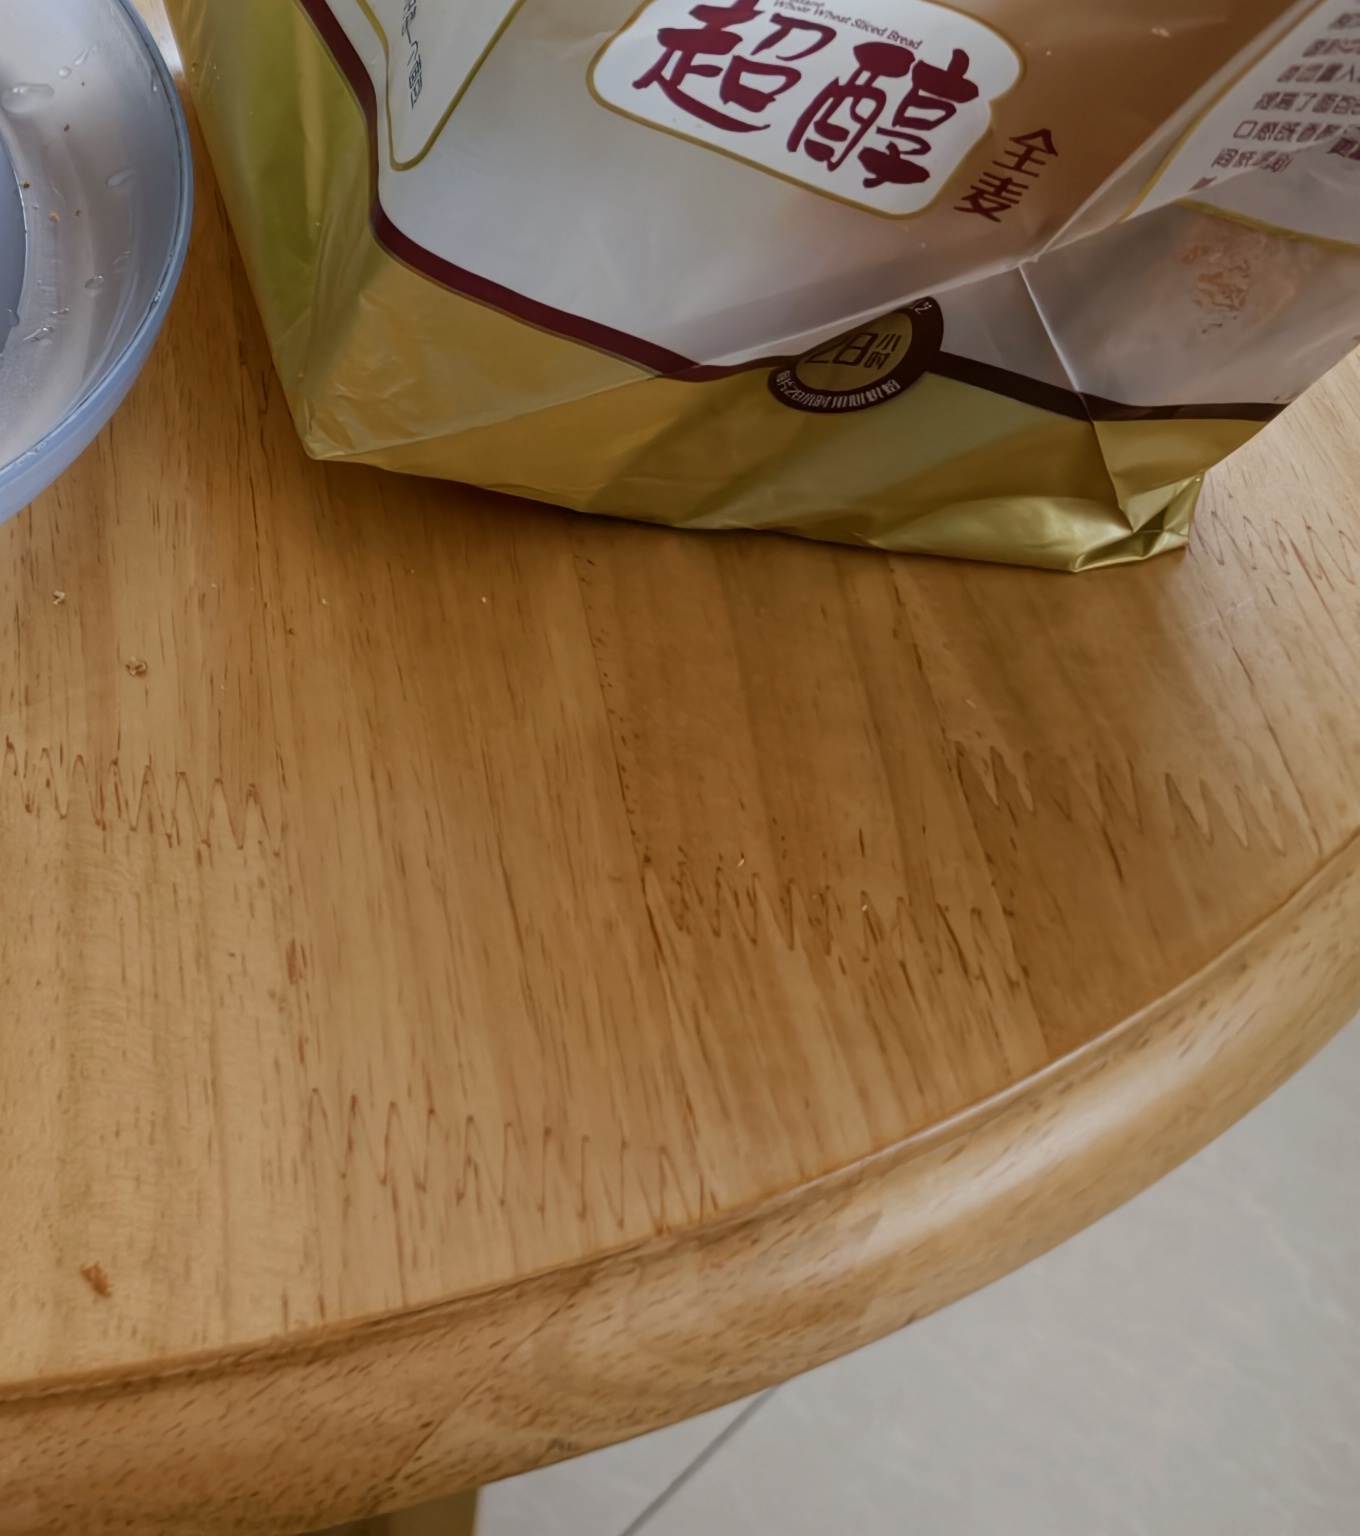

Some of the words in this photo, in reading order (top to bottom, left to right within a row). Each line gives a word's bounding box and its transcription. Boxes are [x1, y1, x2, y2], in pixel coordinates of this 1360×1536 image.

[850, 18, 889, 38] Sliced
[886, 27, 924, 51] Bread
[953, 126, 1061, 224] 全麦
